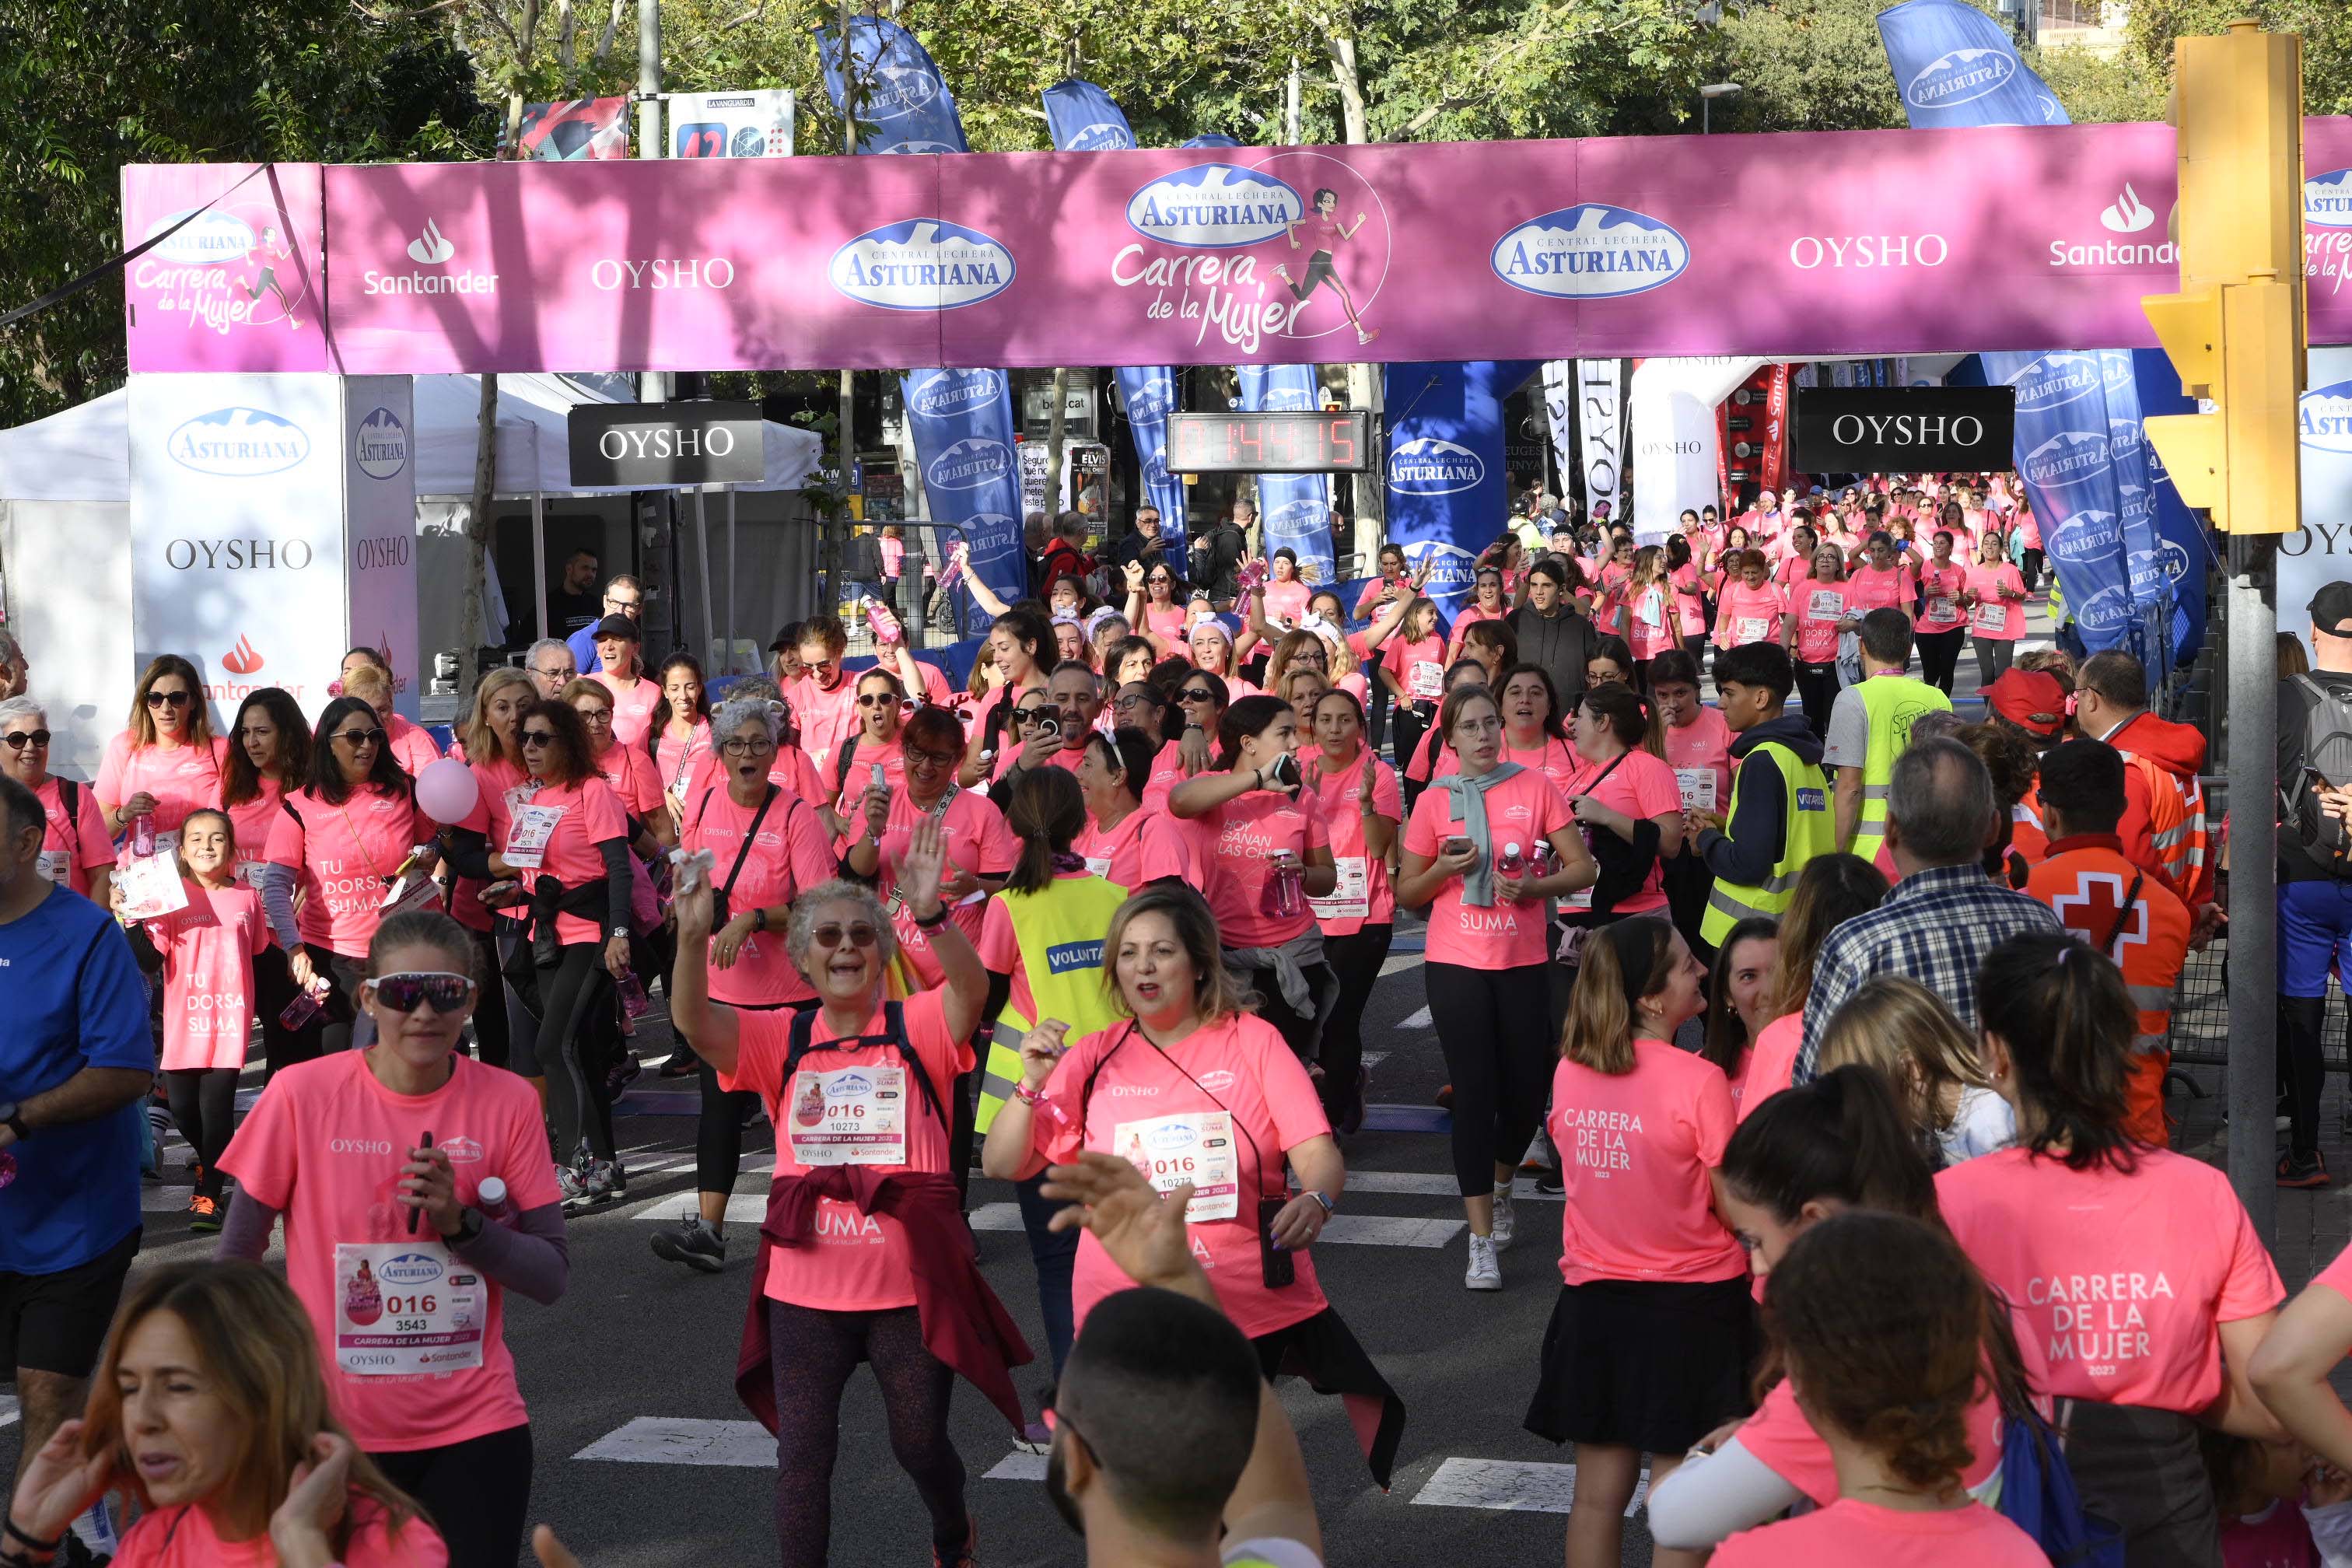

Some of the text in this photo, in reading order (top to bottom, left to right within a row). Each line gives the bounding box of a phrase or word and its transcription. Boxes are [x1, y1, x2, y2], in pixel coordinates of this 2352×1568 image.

[1227, 191, 1283, 200] LECHERA
[1139, 195, 1289, 227] ASTURIANA
[1537, 236, 1667, 247] CENTRAL LECHERA
[1507, 240, 1674, 275] ASTURIANA
[1789, 234, 1948, 268] OYSHO
[591, 257, 735, 290] OYSHO
[845, 252, 1002, 287] ASTURIANA
[1111, 243, 1258, 287] Carrera
[2322, 255, 2336, 276] la
[135, 259, 226, 289] Carrera
[363, 269, 499, 295] Santander
[158, 285, 261, 334] de la Mujer
[1147, 282, 1312, 355] de la Mujer
[1832, 415, 1983, 446] OYSHO
[180, 433, 299, 460] ASTURIANA
[359, 435, 404, 462] ASTURIANA
[600, 426, 734, 460] OYSHO
[1642, 440, 1701, 455] OYSHO
[1082, 454, 1107, 464] ELVIS
[1024, 467, 1037, 476] que
[1390, 460, 1478, 483] ASTURIANA
[165, 539, 313, 570] OYSHO
[357, 535, 409, 571] OYSHO
[1633, 629, 1666, 639] SUMA
[1805, 639, 1829, 648] SUMA
[704, 827, 734, 838] OYSHO
[1223, 819, 1254, 833] HOY
[1220, 831, 1272, 847] GANAN
[1218, 843, 1243, 857] LAS
[319, 859, 343, 876] TU
[328, 895, 381, 913] SUMA
[180, 914, 212, 925] OYSHO
[1460, 912, 1517, 931] SUMA
[186, 974, 206, 989] TU
[188, 1015, 238, 1032] SUMA
[1112, 1085, 1160, 1097] OYSHO
[828, 1104, 866, 1118] 016
[830, 1122, 860, 1132] 10273
[1564, 1108, 1643, 1133] CARRERA
[331, 1138, 392, 1155] OYSHO
[1577, 1130, 1627, 1150] DE LA
[802, 1149, 832, 1158] OYSHO
[1576, 1149, 1631, 1171] MUJER
[1155, 1157, 1195, 1174] 016
[1195, 1201, 1232, 1213] Santander
[383, 1265, 442, 1278] ASTURIANA
[2028, 1271, 2175, 1305] CARRERA
[387, 1295, 437, 1314] 016
[395, 1319, 427, 1332] 3543
[2053, 1304, 2147, 1332] DE LA
[354, 1337, 394, 1346] CARRERA
[422, 1335, 451, 1344] MUJER
[2049, 1332, 2151, 1361] MUJER
[349, 1350, 473, 1367] OYSHO Santander
[2088, 1364, 2116, 1377] 2023
